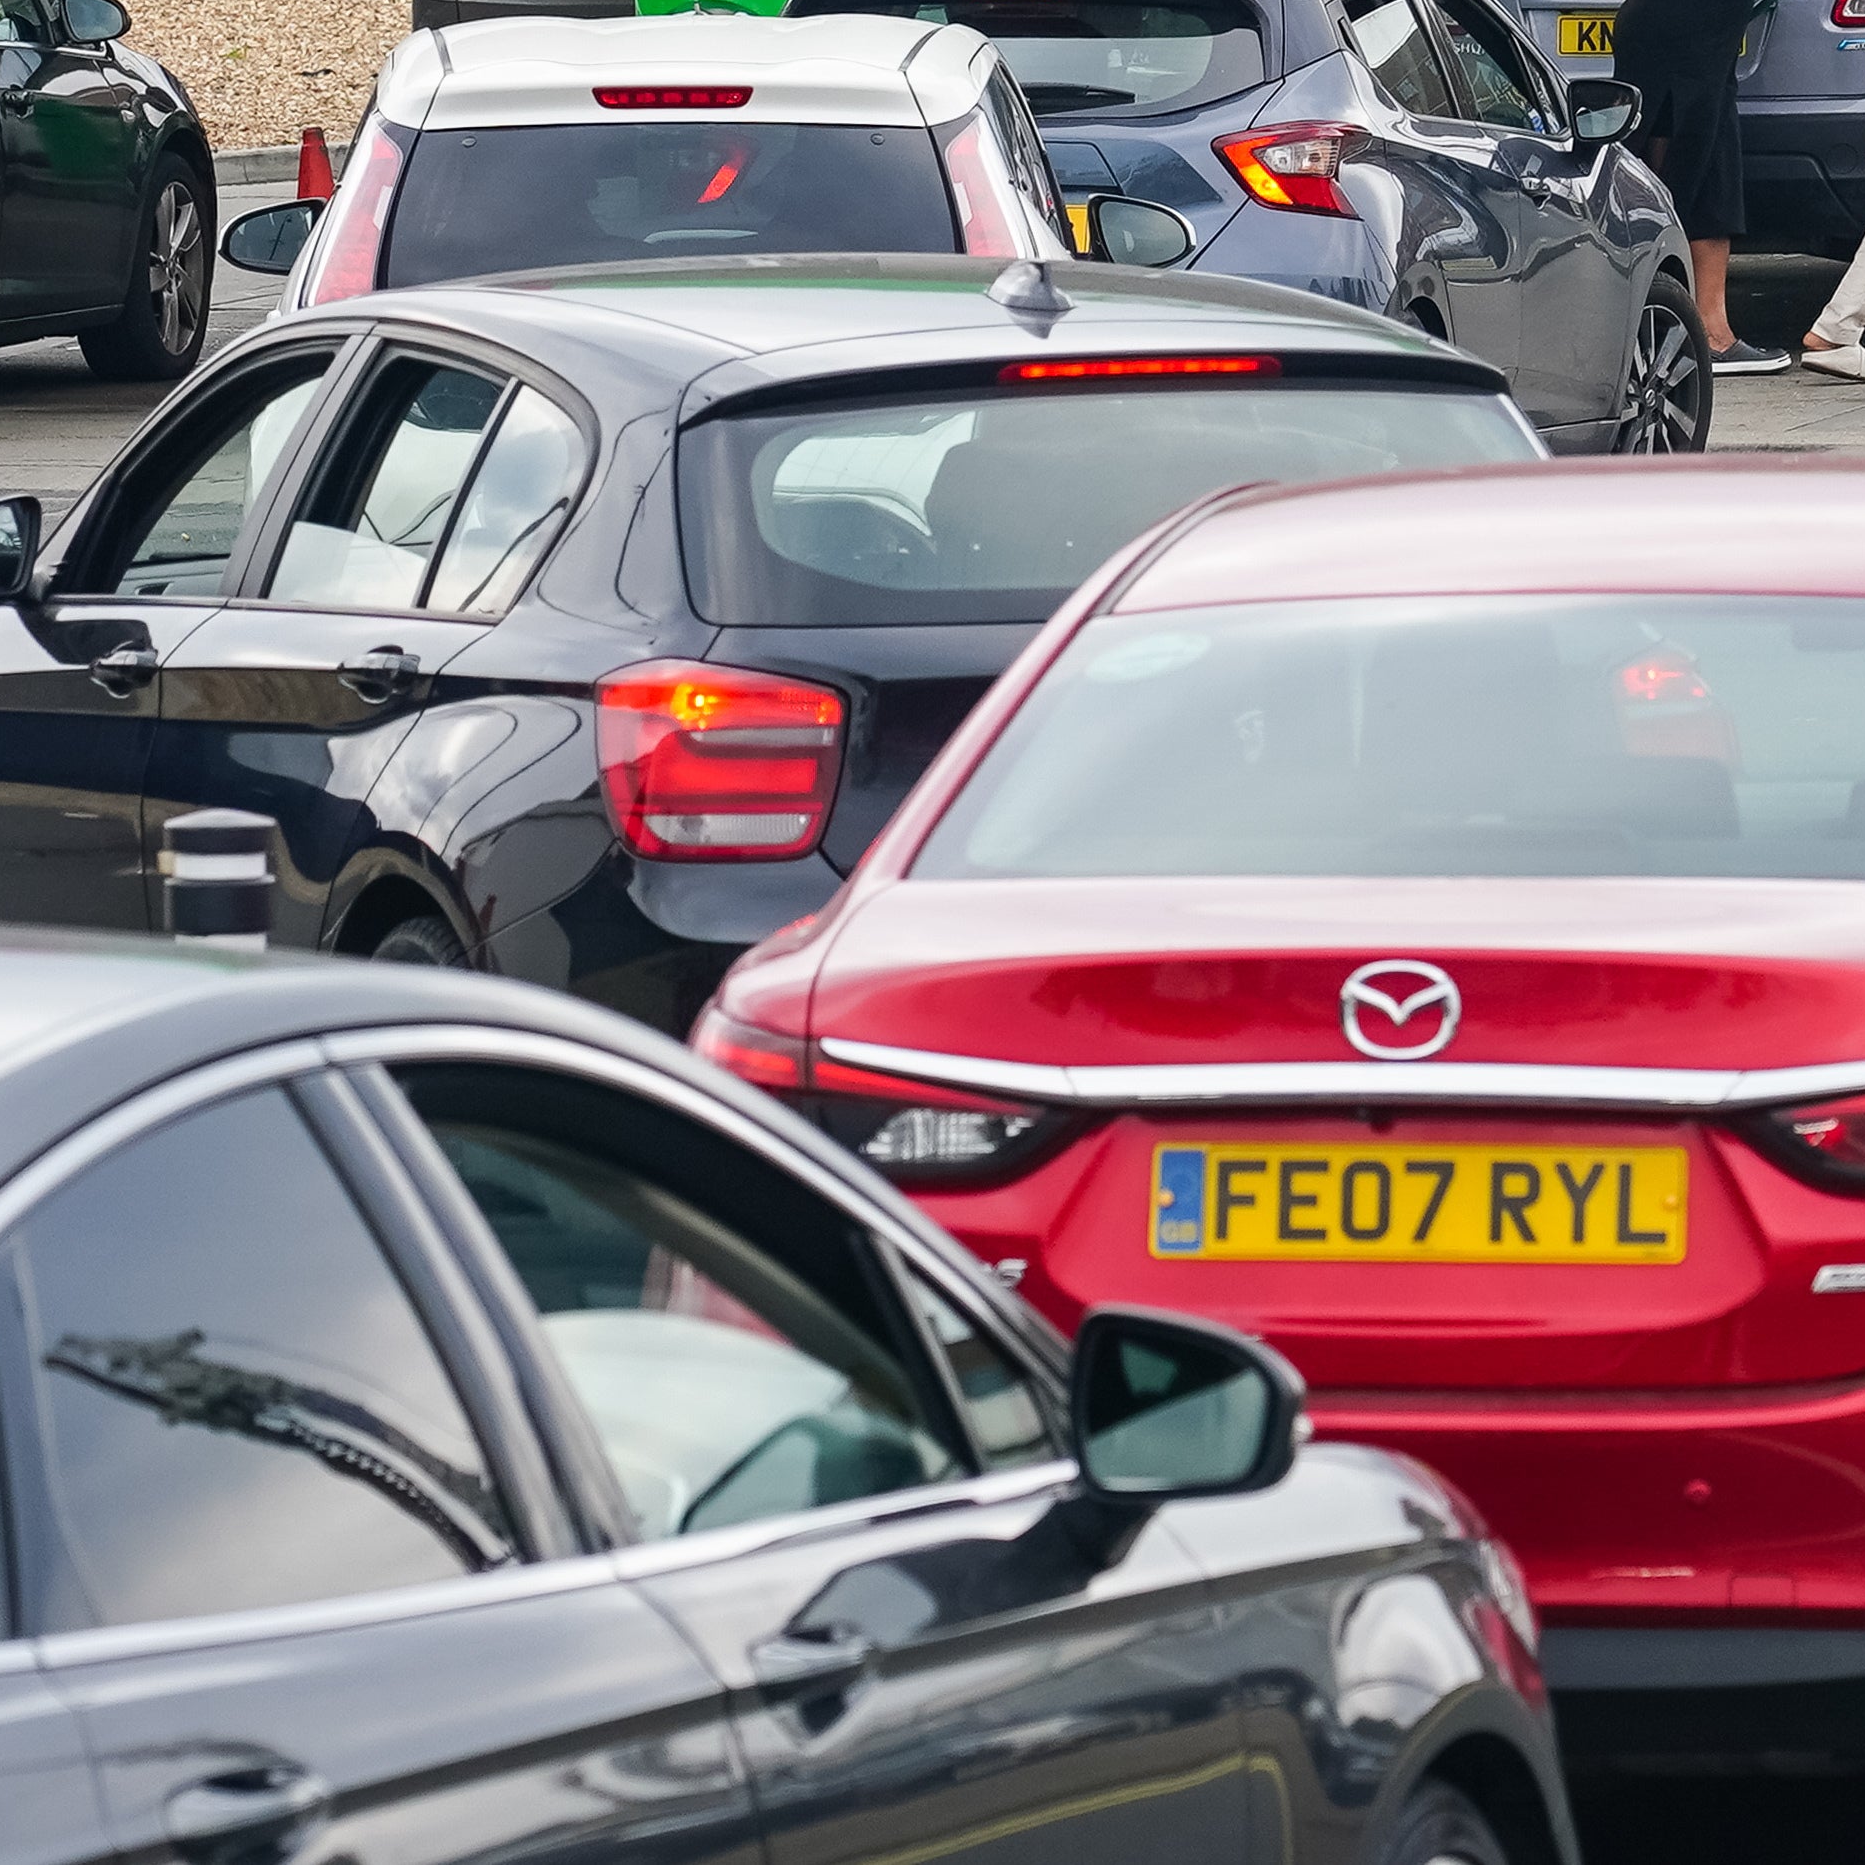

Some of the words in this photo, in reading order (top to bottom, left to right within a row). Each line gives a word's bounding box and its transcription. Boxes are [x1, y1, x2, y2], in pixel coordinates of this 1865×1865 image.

[1577, 21, 1615, 52] KN
[1214, 1160, 1455, 1244] FE07
[1489, 1162, 1667, 1245] RYL
[1161, 1220, 1198, 1244] GB
